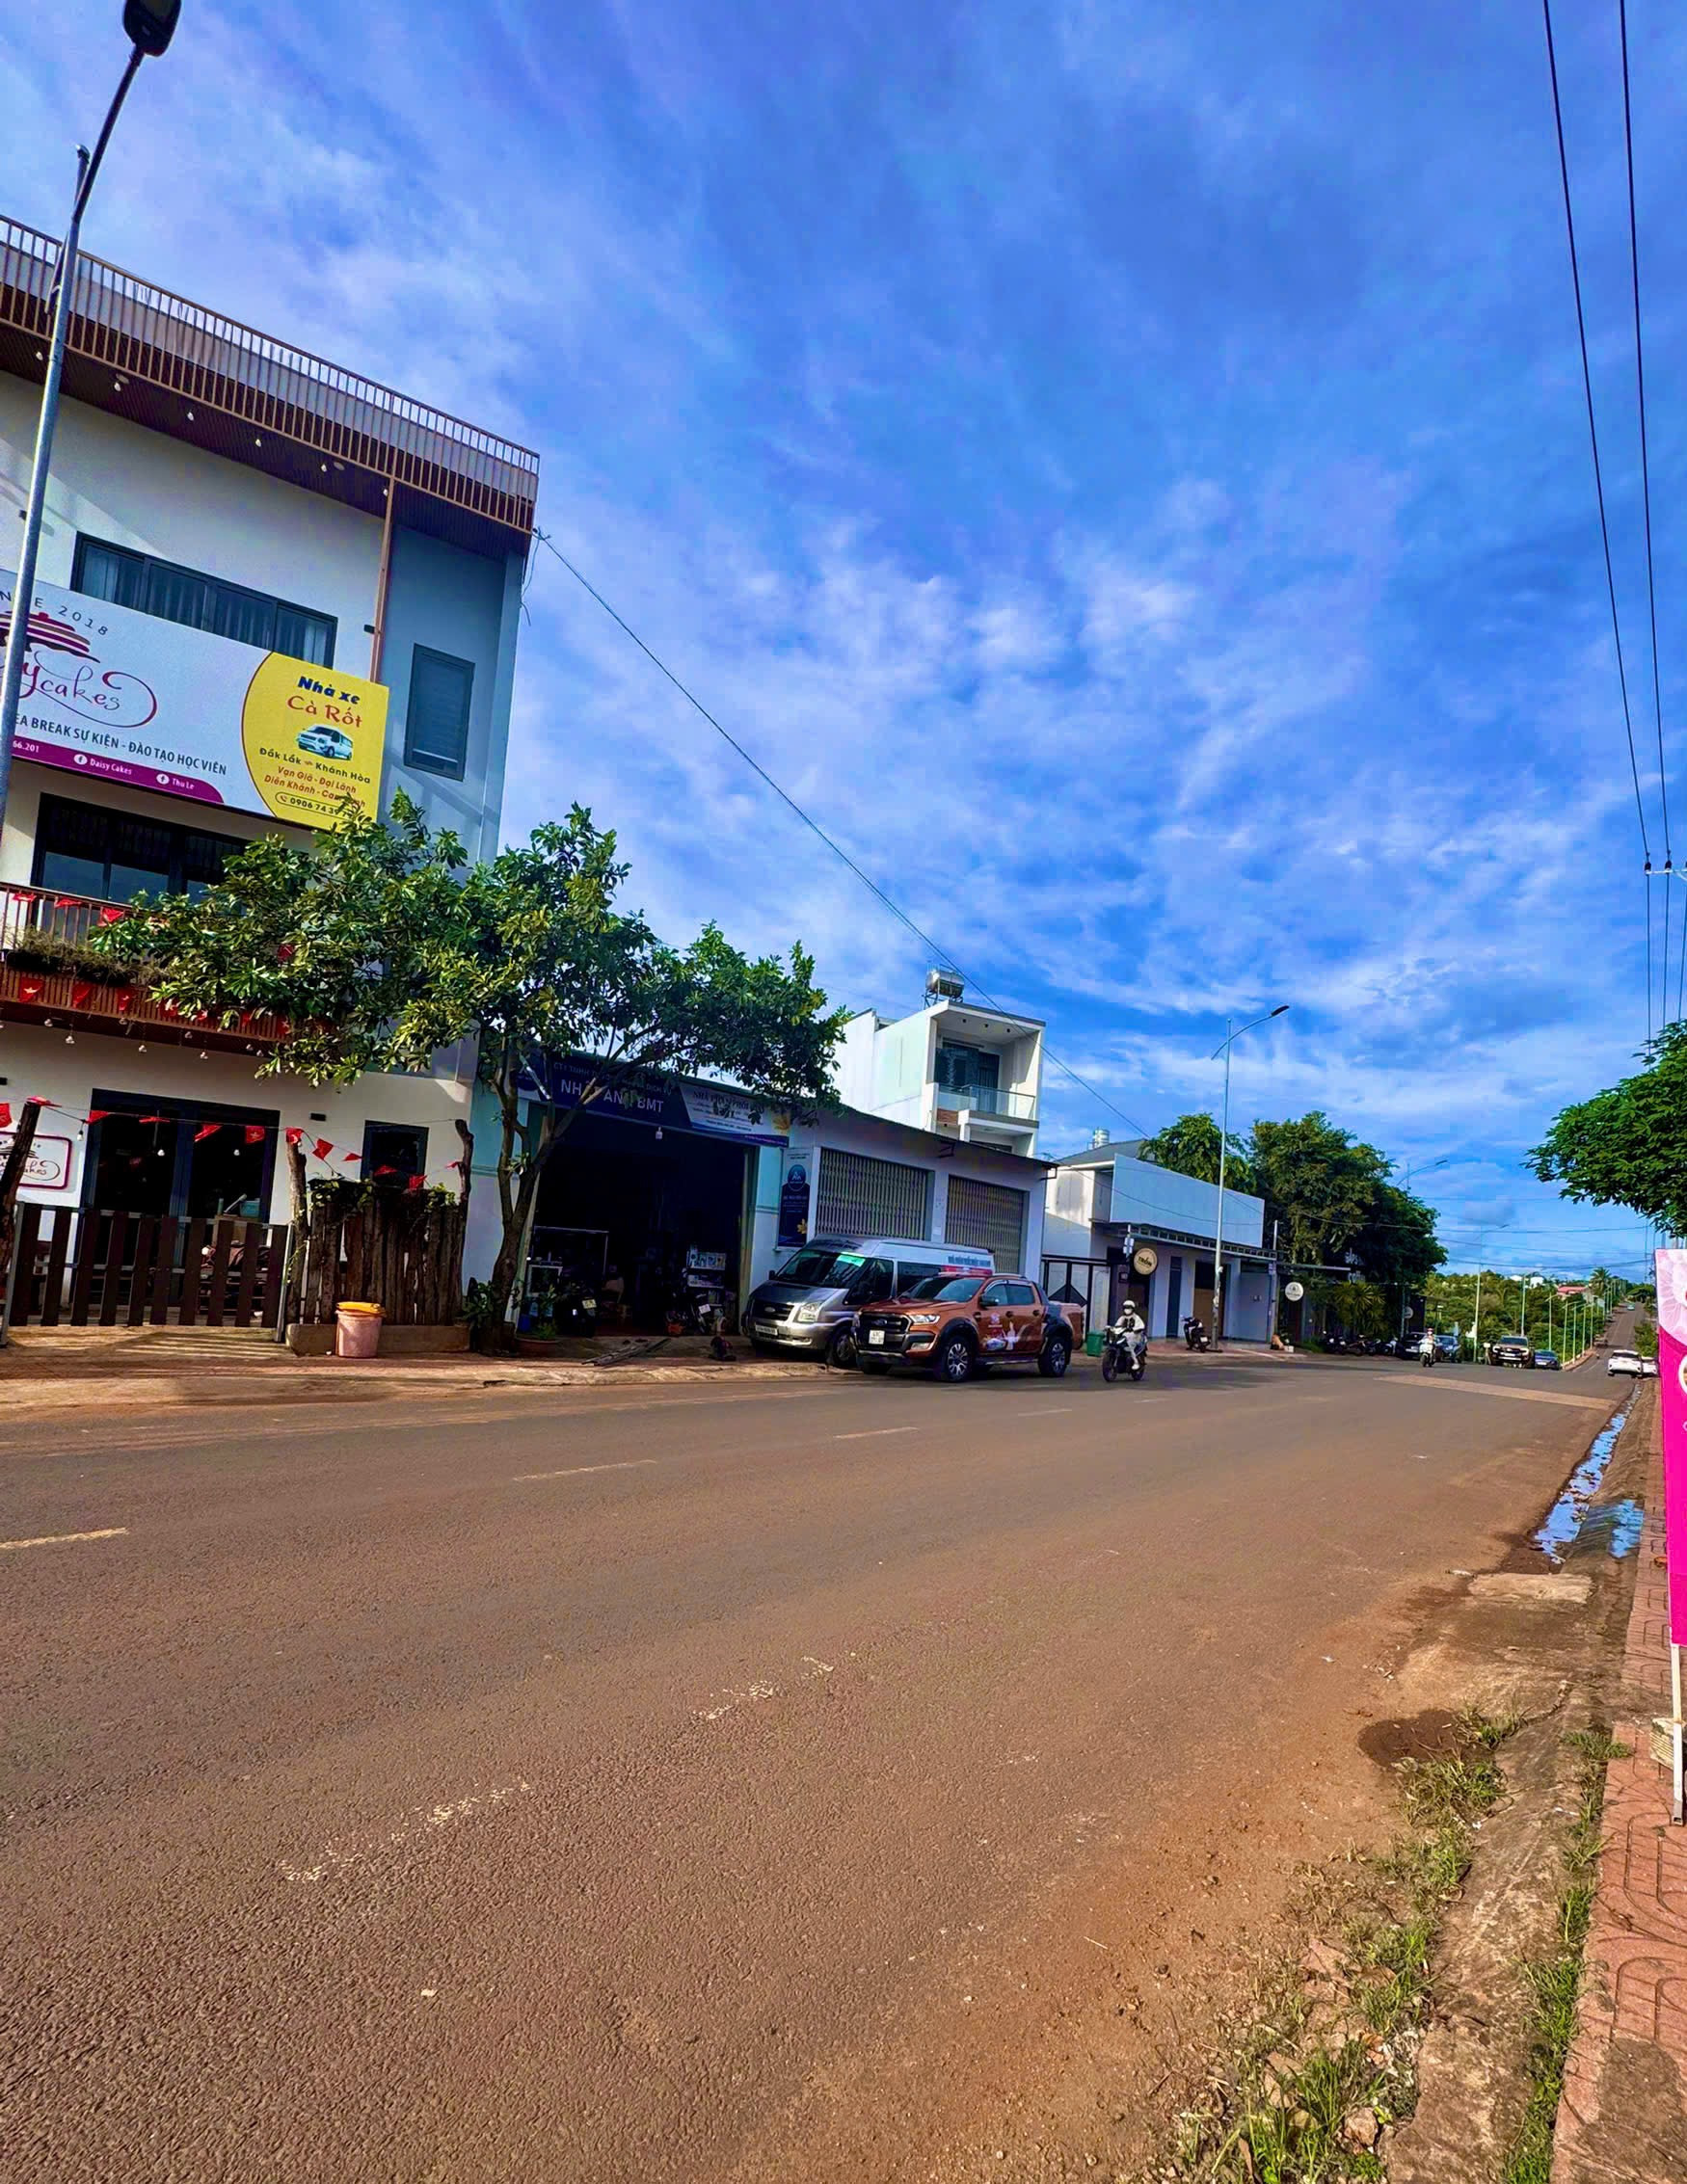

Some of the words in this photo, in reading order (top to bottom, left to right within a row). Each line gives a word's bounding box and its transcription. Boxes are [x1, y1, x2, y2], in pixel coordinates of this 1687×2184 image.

[58, 605, 108, 636] 2018
[297, 676, 335, 698] Nhà
[338, 691, 361, 705] xe
[287, 695, 317, 715] Cà
[325, 706, 362, 728] Rốt
[12, 739, 40, 754] 66.201
[14, 715, 28, 727] EA
[31, 717, 71, 737] BREAK
[73, 728, 91, 744] SỰ
[92, 732, 120, 749] KIỆN
[128, 741, 152, 757] ĐÀO
[154, 748, 175, 762] TẠO
[177, 754, 200, 769] HỌC
[201, 759, 227, 775] VIÊN
[90, 758, 110, 771] Daisy
[111, 763, 132, 775] Cakes
[278, 765, 295, 777] Vạn
[315, 761, 348, 778] Khánh
[350, 772, 371, 784] Hòa
[172, 777, 186, 788] Thu
[286, 781, 315, 795] Khánh
[289, 797, 313, 810] 0906
[315, 804, 327, 813] 74
[636, 1097, 664, 1113] BMT
